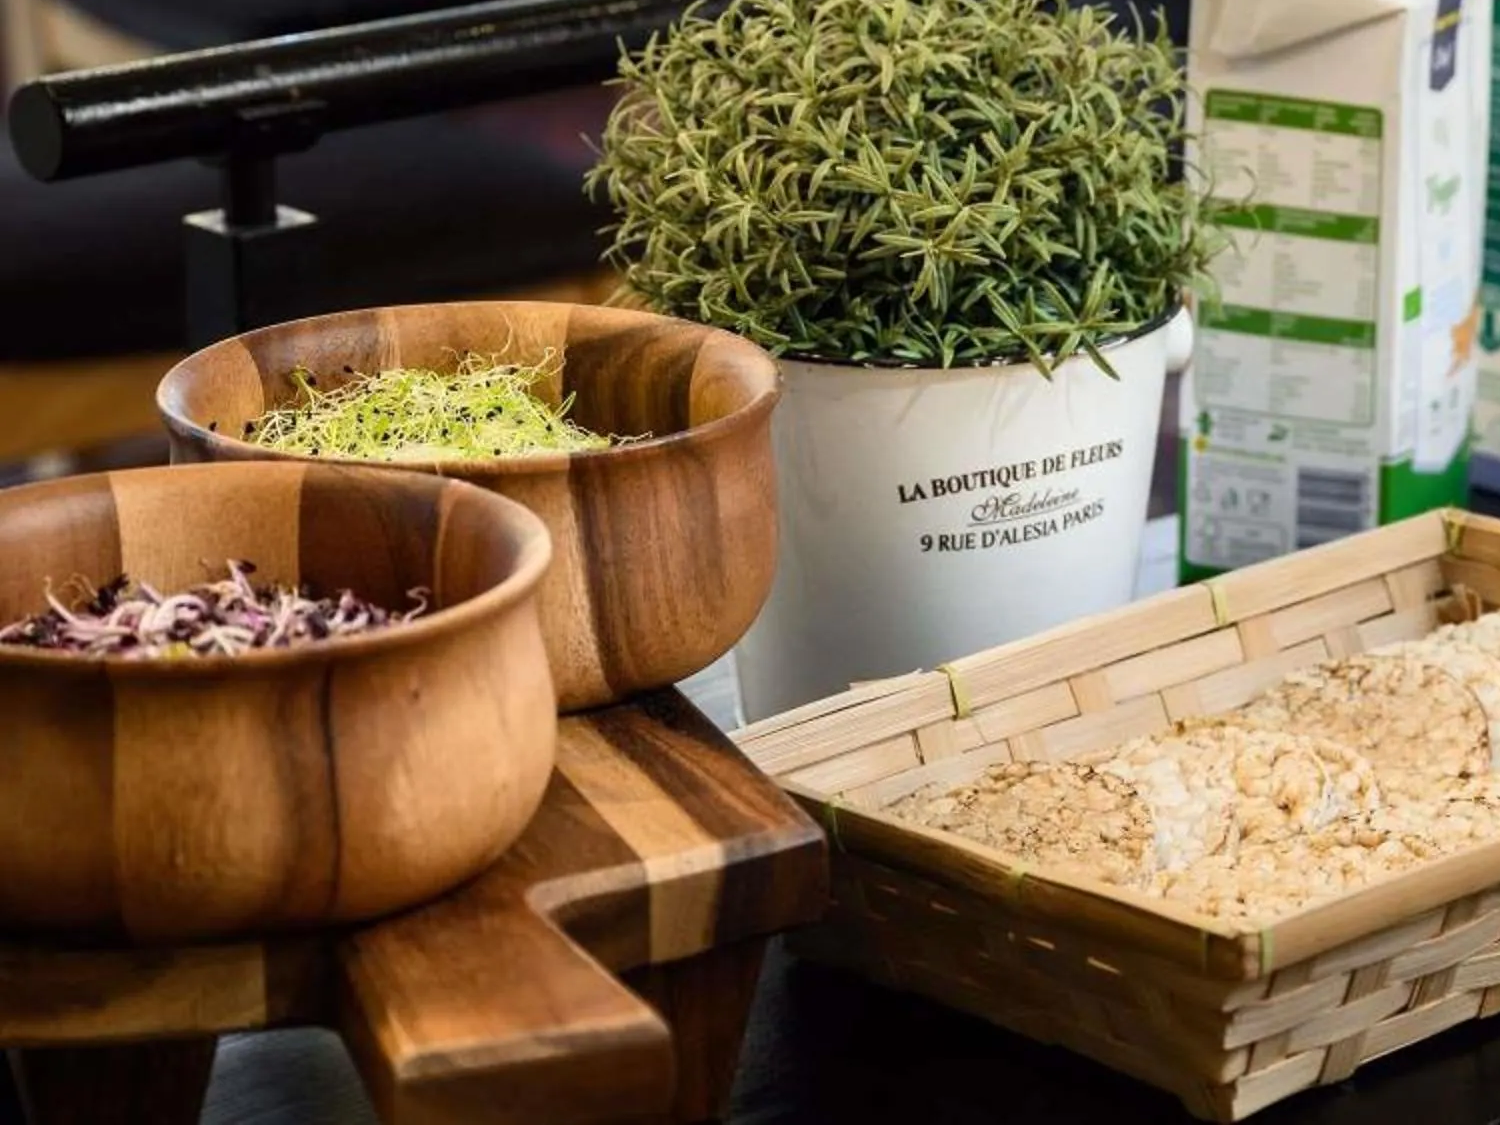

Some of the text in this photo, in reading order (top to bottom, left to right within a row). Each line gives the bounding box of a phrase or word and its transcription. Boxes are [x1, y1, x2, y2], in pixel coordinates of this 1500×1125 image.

[897, 438, 1124, 503] LA BOUTIQUE DE FLEURS
[920, 498, 1105, 553] 9 RUE D'ALESIA PARIS
